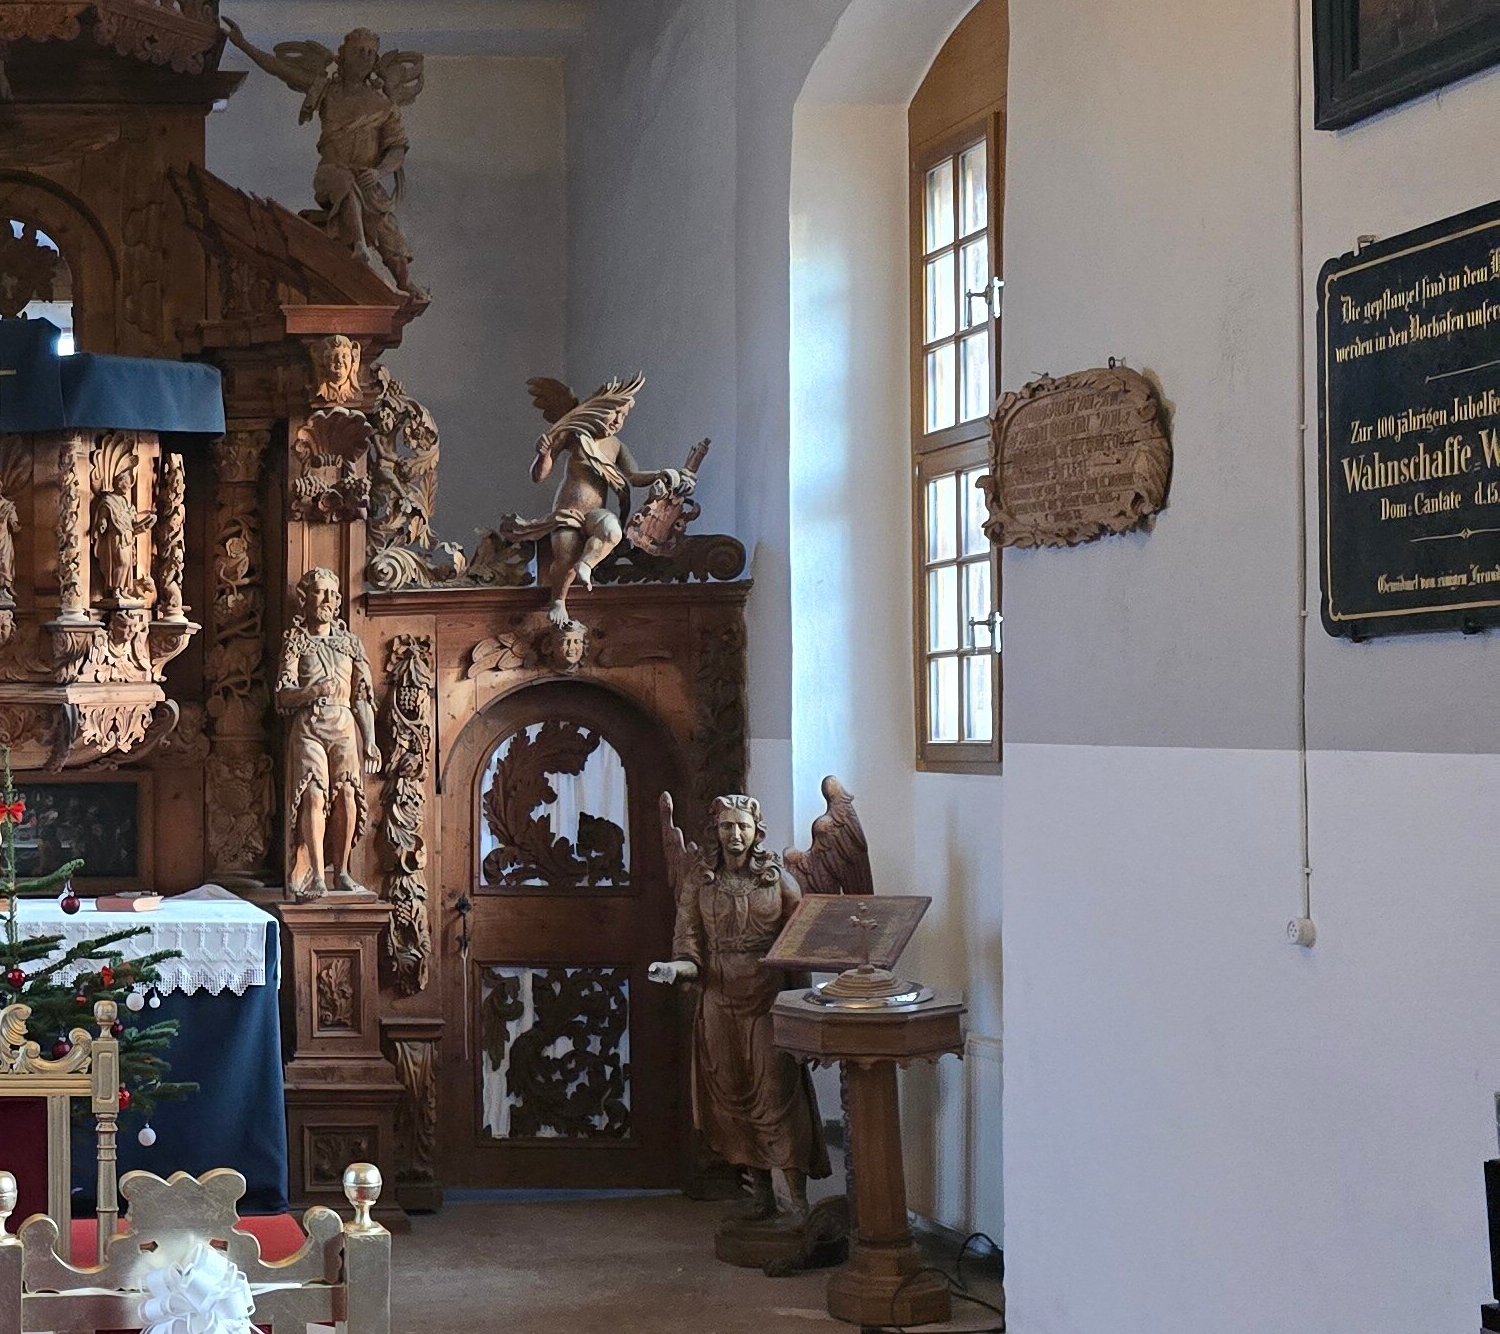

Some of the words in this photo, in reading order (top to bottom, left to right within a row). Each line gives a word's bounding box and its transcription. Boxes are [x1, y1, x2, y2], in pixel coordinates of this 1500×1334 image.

[1341, 295, 1360, 324] Die
[1463, 265, 1488, 288] dem
[1335, 336, 1373, 363] werden
[1375, 332, 1386, 352] in
[1388, 326, 1408, 348] den
[1351, 420, 1373, 444] Zur
[1414, 490, 1462, 516] Cantate
